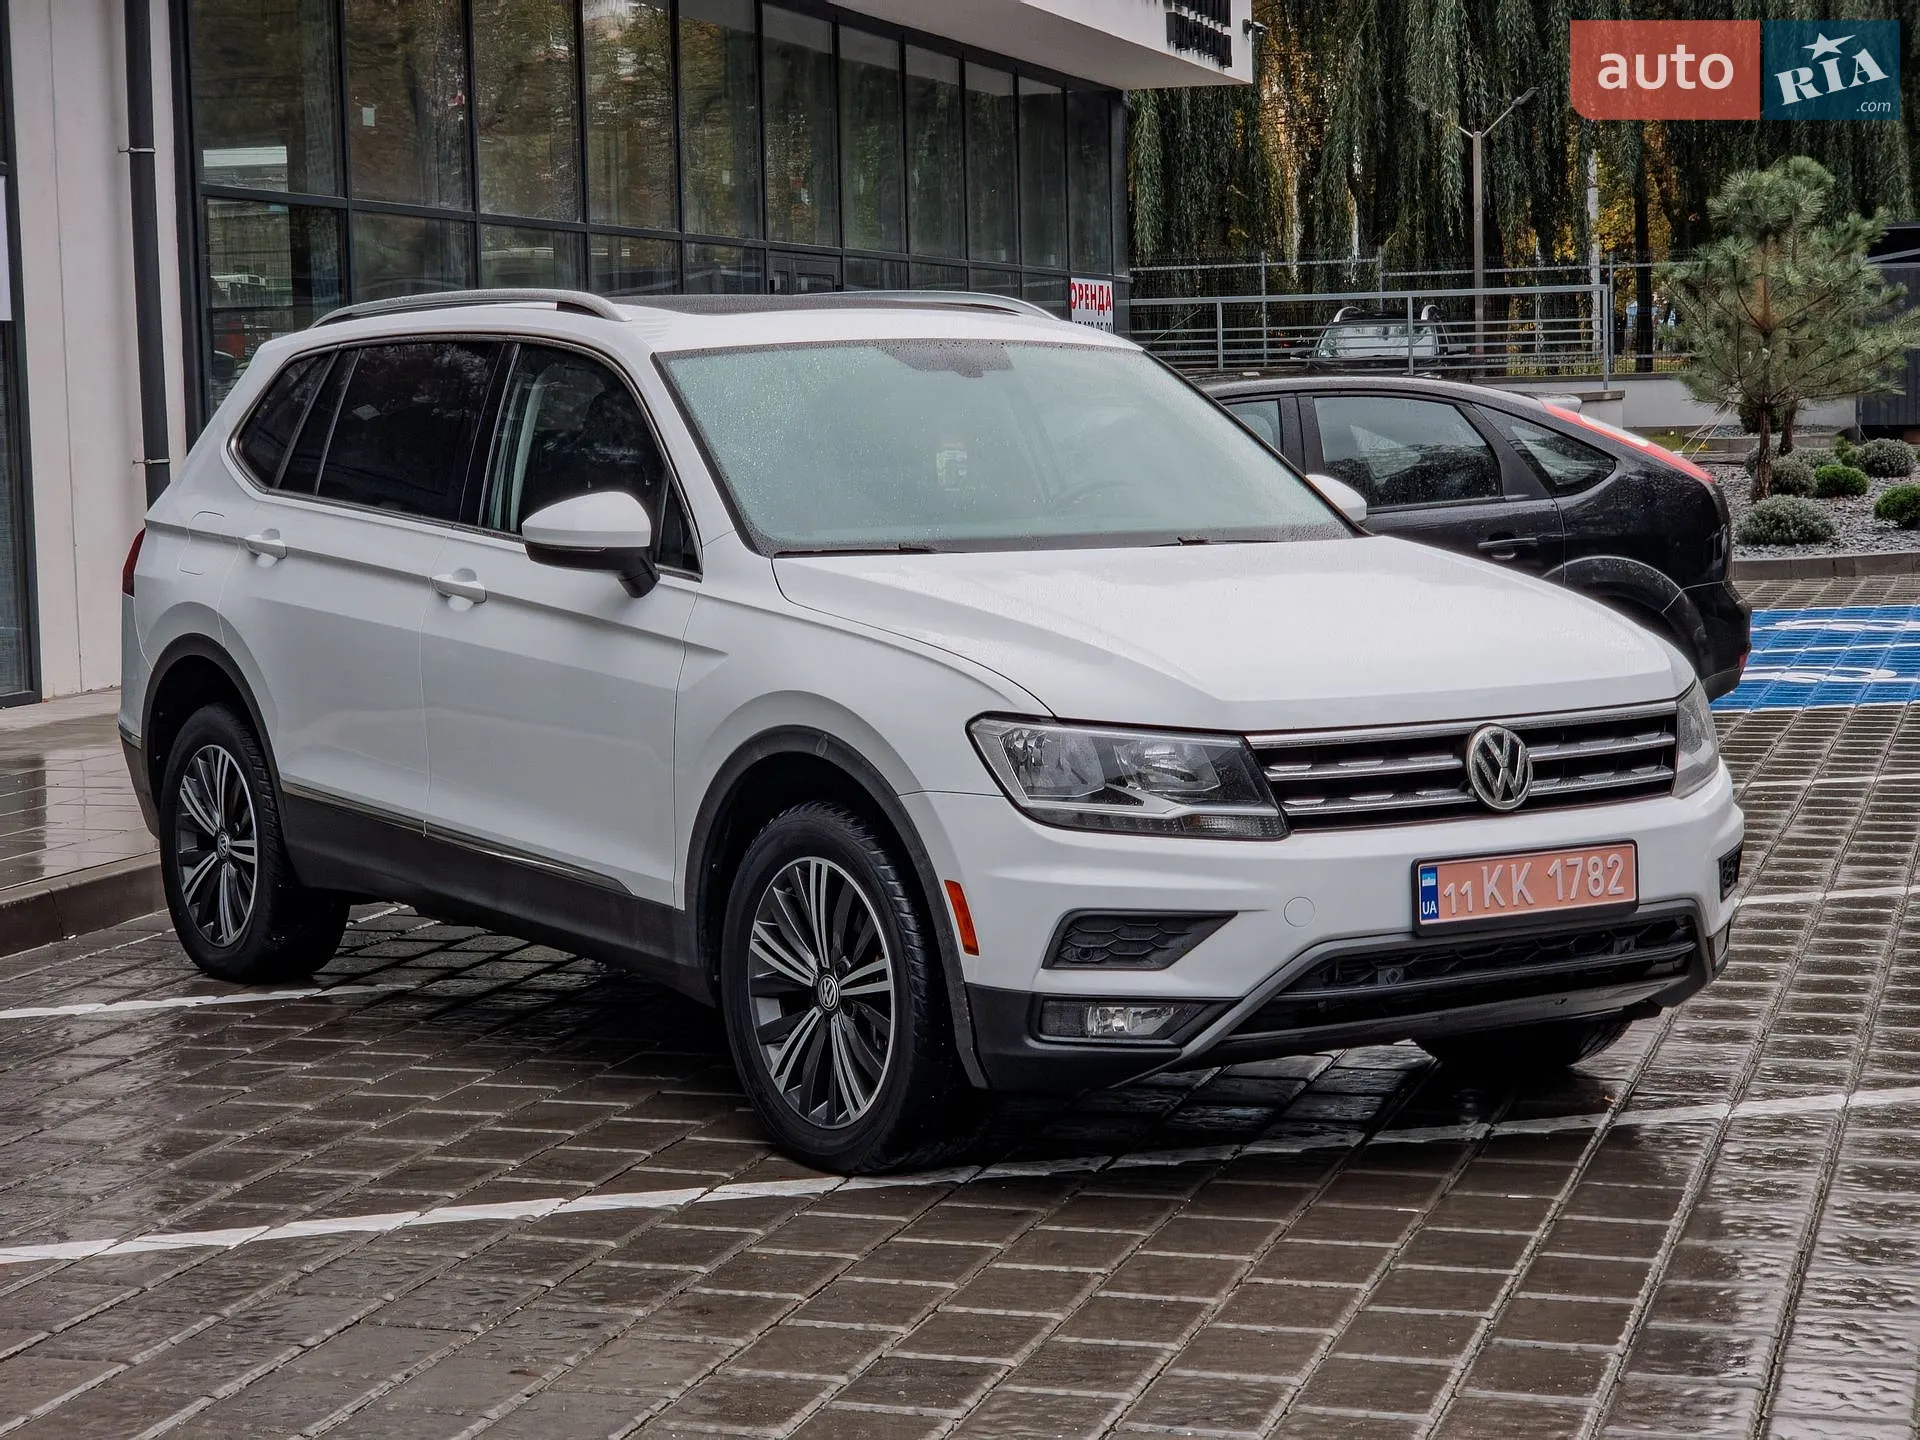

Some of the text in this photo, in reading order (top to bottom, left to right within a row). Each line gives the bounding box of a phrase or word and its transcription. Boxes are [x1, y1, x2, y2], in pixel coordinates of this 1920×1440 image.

[1070, 282, 1112, 316] ОРЕНДА
[1547, 853, 1625, 901] 1782
[1422, 900, 1437, 915] UA
